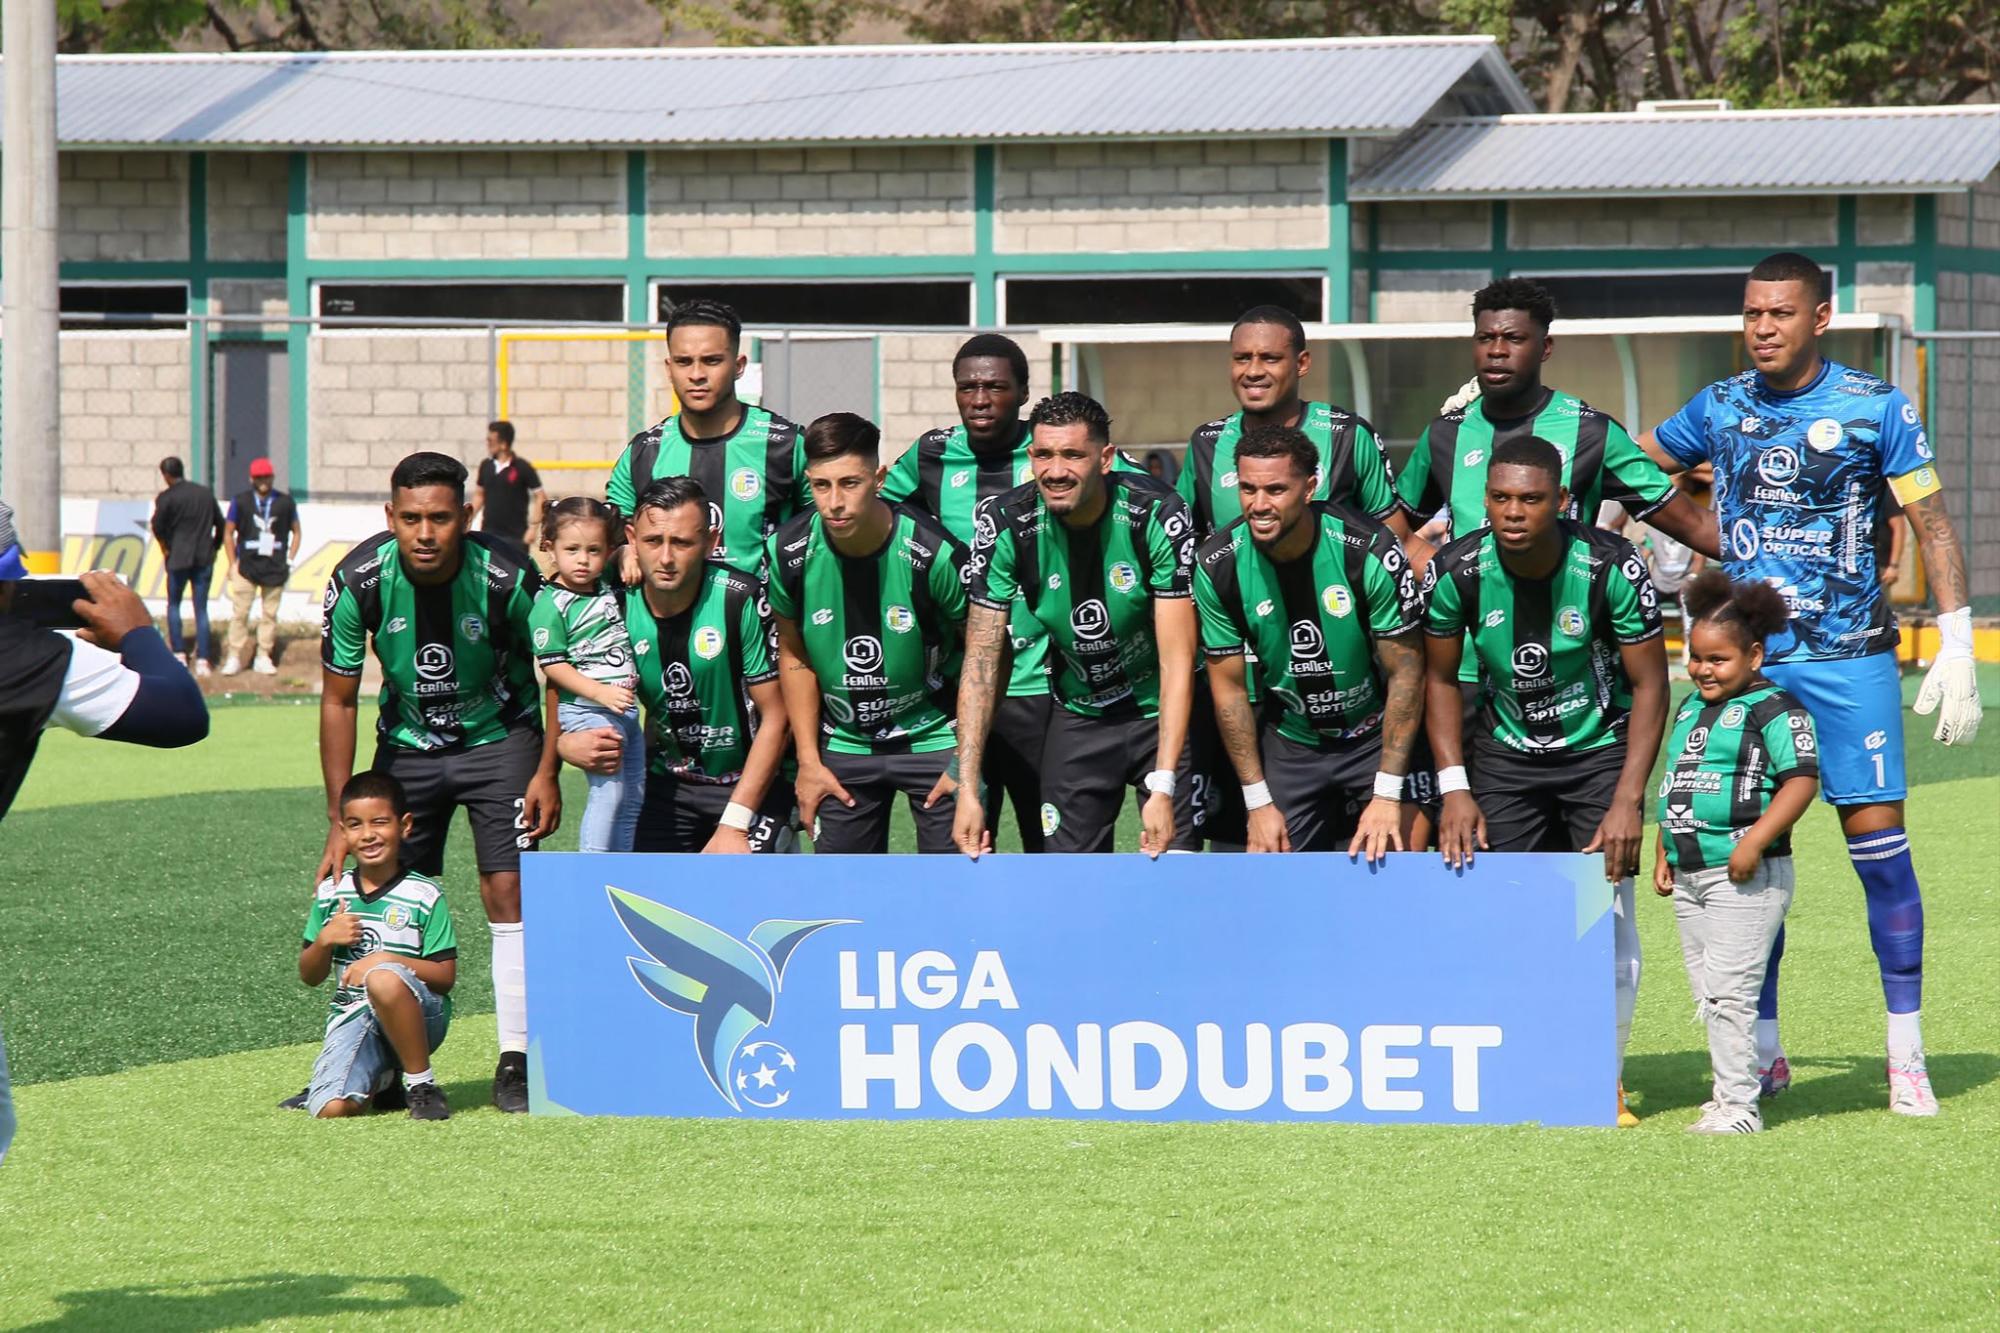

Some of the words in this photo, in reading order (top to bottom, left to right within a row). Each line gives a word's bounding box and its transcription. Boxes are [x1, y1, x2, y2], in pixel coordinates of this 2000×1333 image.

[1204, 534, 1245, 564] CONSTEC
[1761, 539, 1832, 557] ÓPTICAS
[1526, 695, 1590, 722] ÓPTICAS
[1672, 780, 1722, 790] ÓPTICAS
[1871, 753, 1886, 788] 1
[839, 950, 1020, 1010] LIGA
[839, 1020, 1504, 1113] HONDUBET
